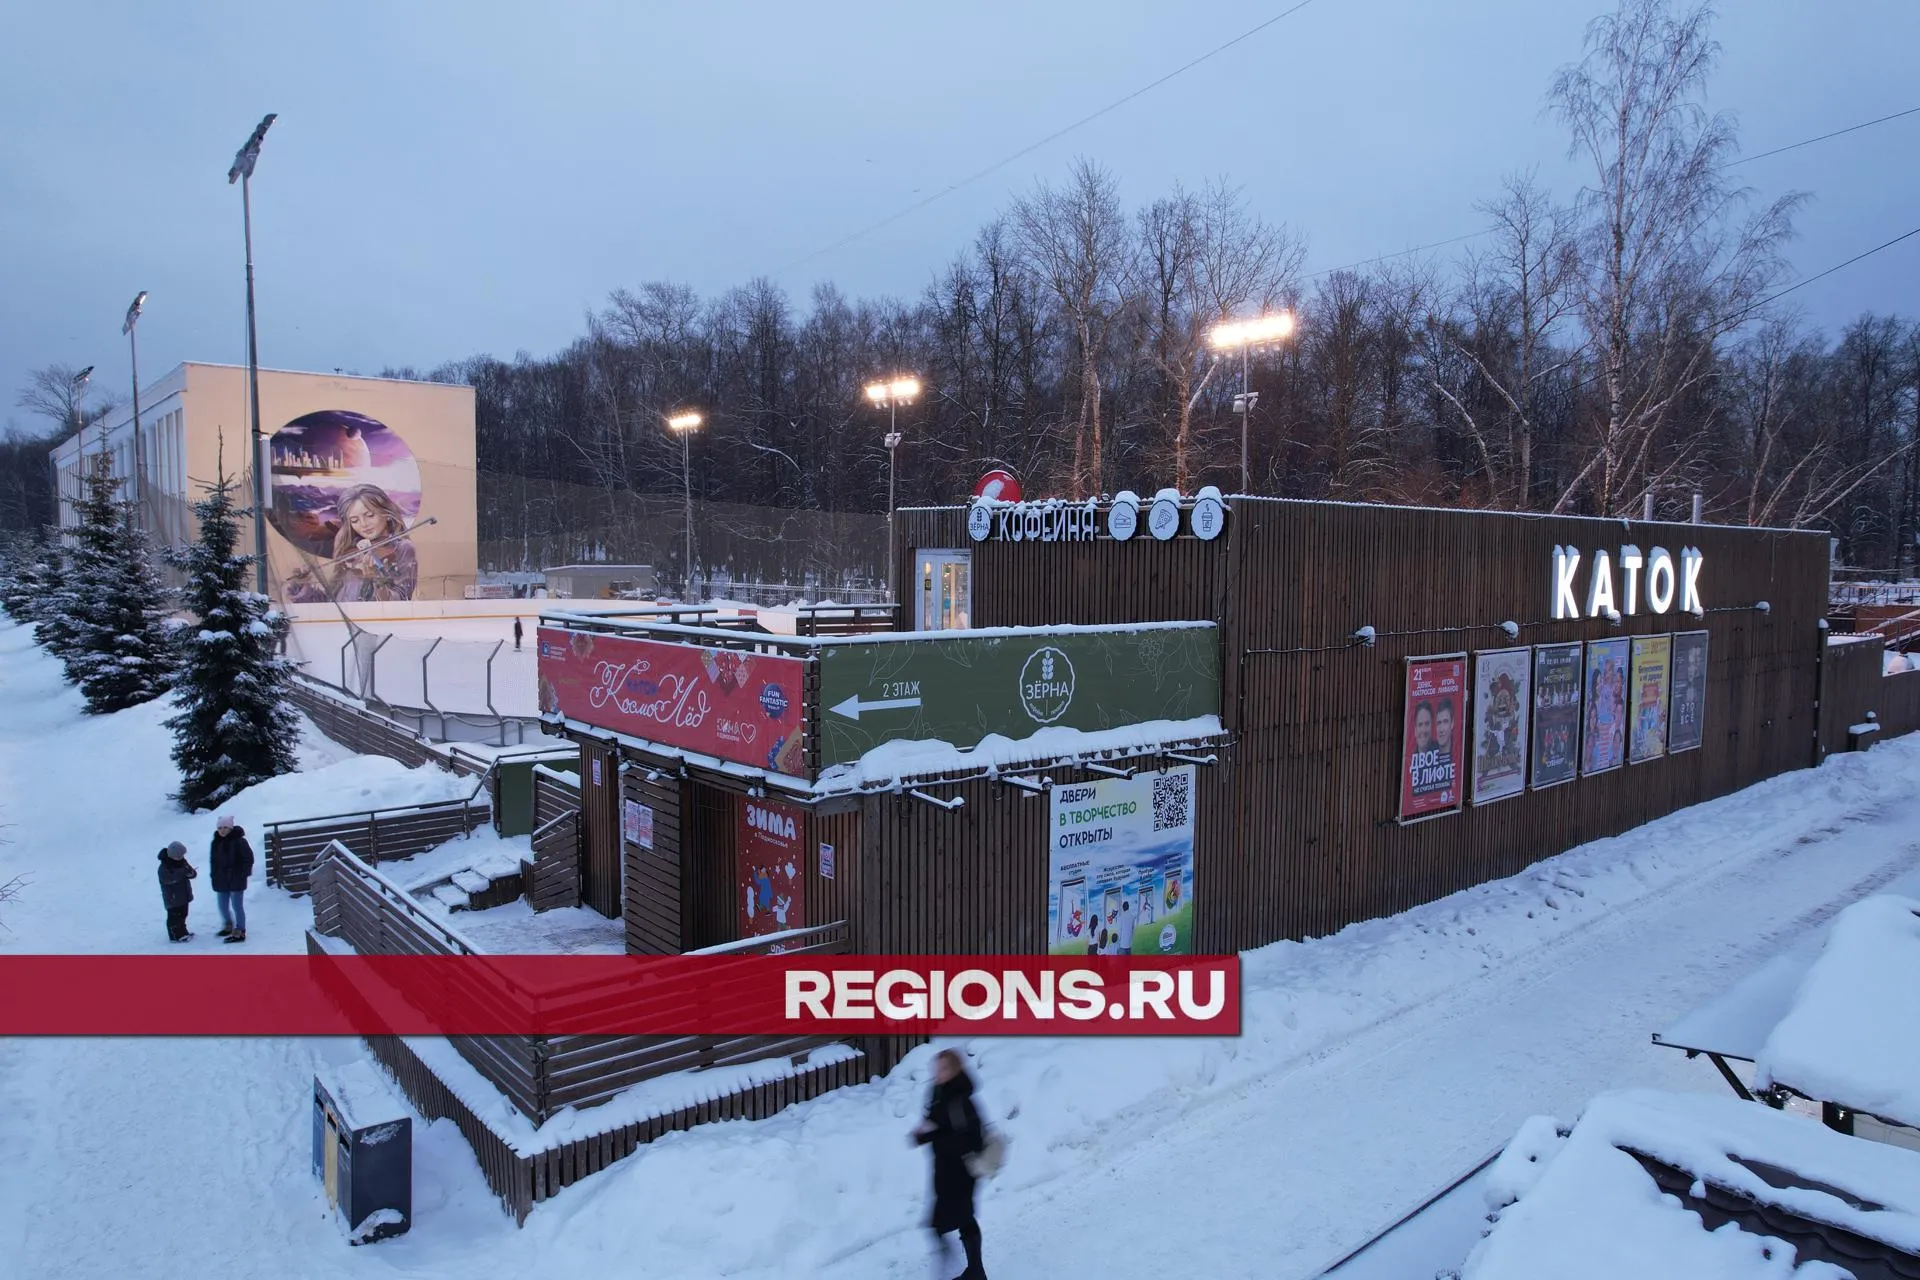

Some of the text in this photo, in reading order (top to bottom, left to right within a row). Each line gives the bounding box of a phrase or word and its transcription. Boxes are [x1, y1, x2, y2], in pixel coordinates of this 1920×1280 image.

[1551, 552, 1703, 619] КАТОК
[1413, 668, 1423, 681] 21
[767, 690, 780, 698] FUN
[883, 681, 920, 698] 2 ЭТАЖ
[1025, 680, 1069, 700] ЗЁРНА
[759, 696, 788, 707] FANTASTIC
[1409, 749, 1440, 774] ДВОЕ
[1412, 763, 1456, 787] В ЛИФТЕ
[1060, 787, 1096, 804] ДВЕРИ
[746, 804, 796, 840] ЗИМА
[1060, 801, 1137, 826] В ТВОРЧЕСТВО
[1059, 827, 1113, 848] ОТКРЫТЫ
